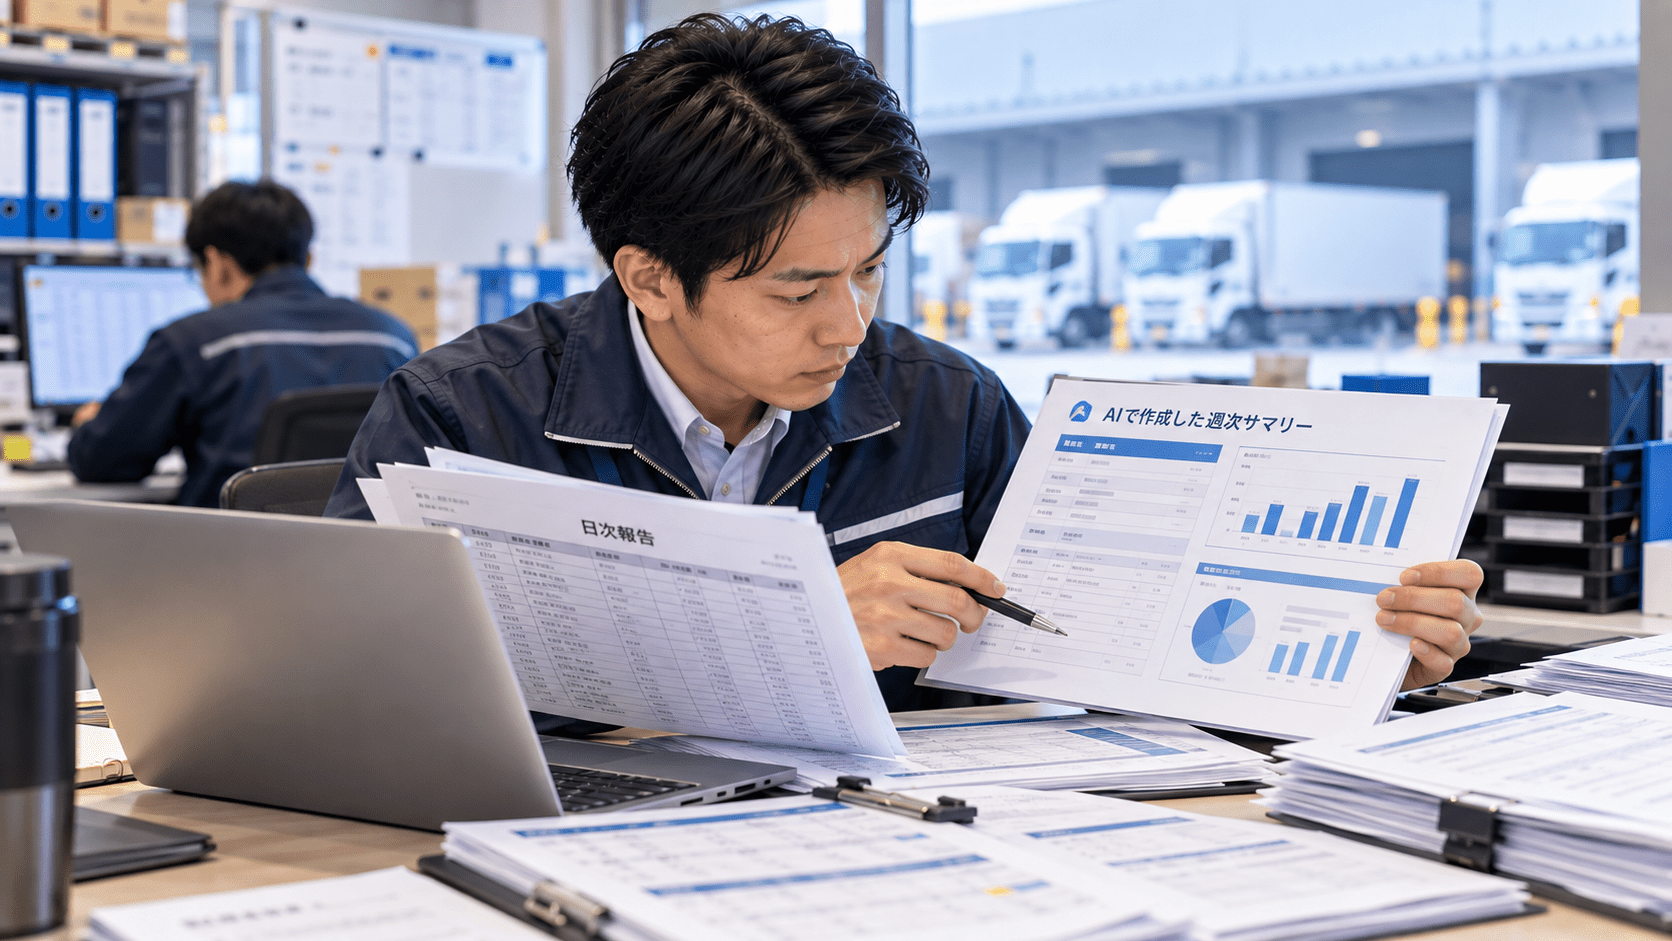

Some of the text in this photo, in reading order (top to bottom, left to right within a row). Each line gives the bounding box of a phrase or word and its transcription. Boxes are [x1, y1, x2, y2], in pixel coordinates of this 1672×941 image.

[1102, 407, 1313, 433] AIで作成した週次サマリー
[581, 519, 655, 547] 日次報告
